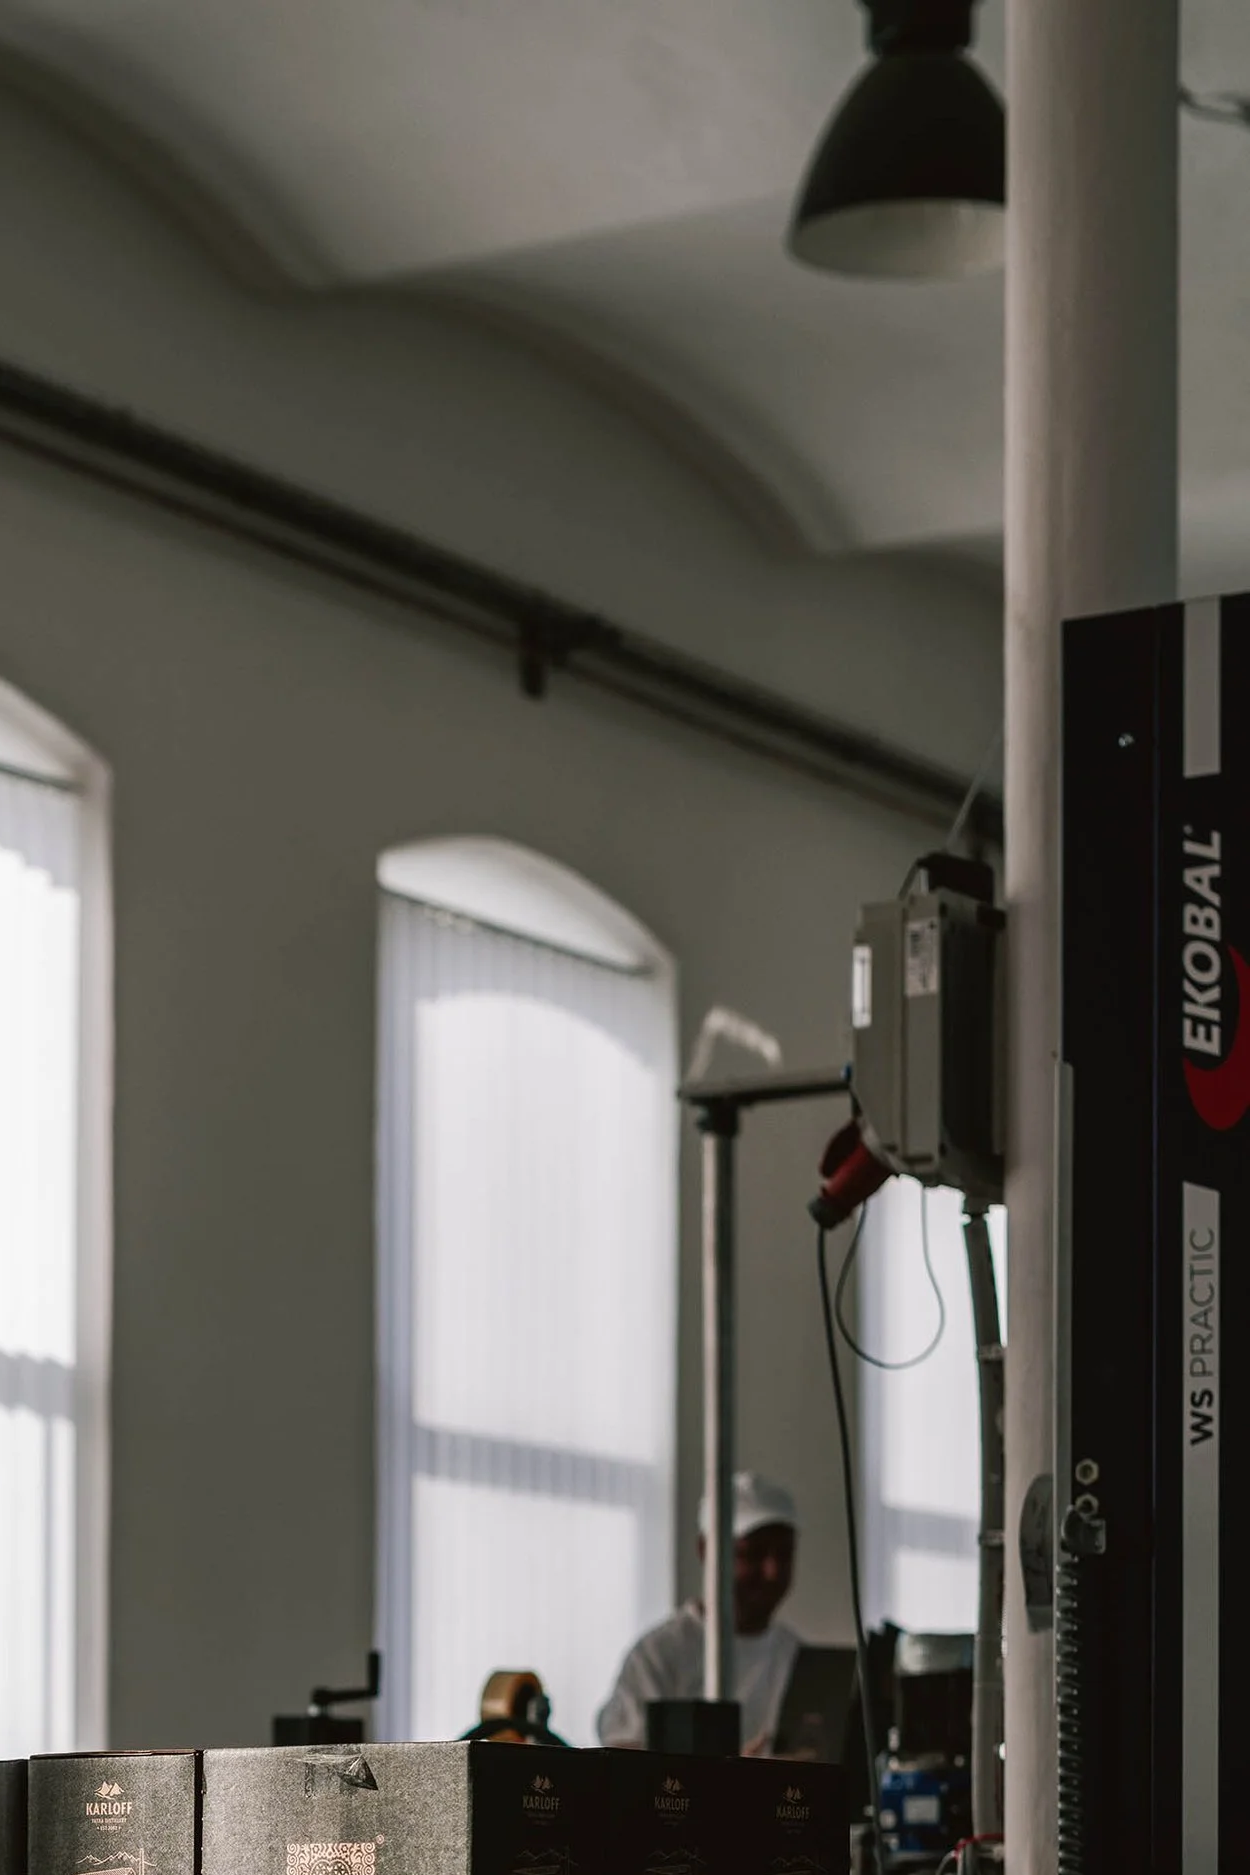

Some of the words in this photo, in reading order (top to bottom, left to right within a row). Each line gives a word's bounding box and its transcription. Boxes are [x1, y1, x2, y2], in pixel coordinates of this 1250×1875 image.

[1183, 828, 1221, 1057] EKOBAL
[1189, 1226, 1215, 1381] PRACTIC
[1190, 1387, 1215, 1447] WS
[86, 1802, 133, 1815] KARLOFF
